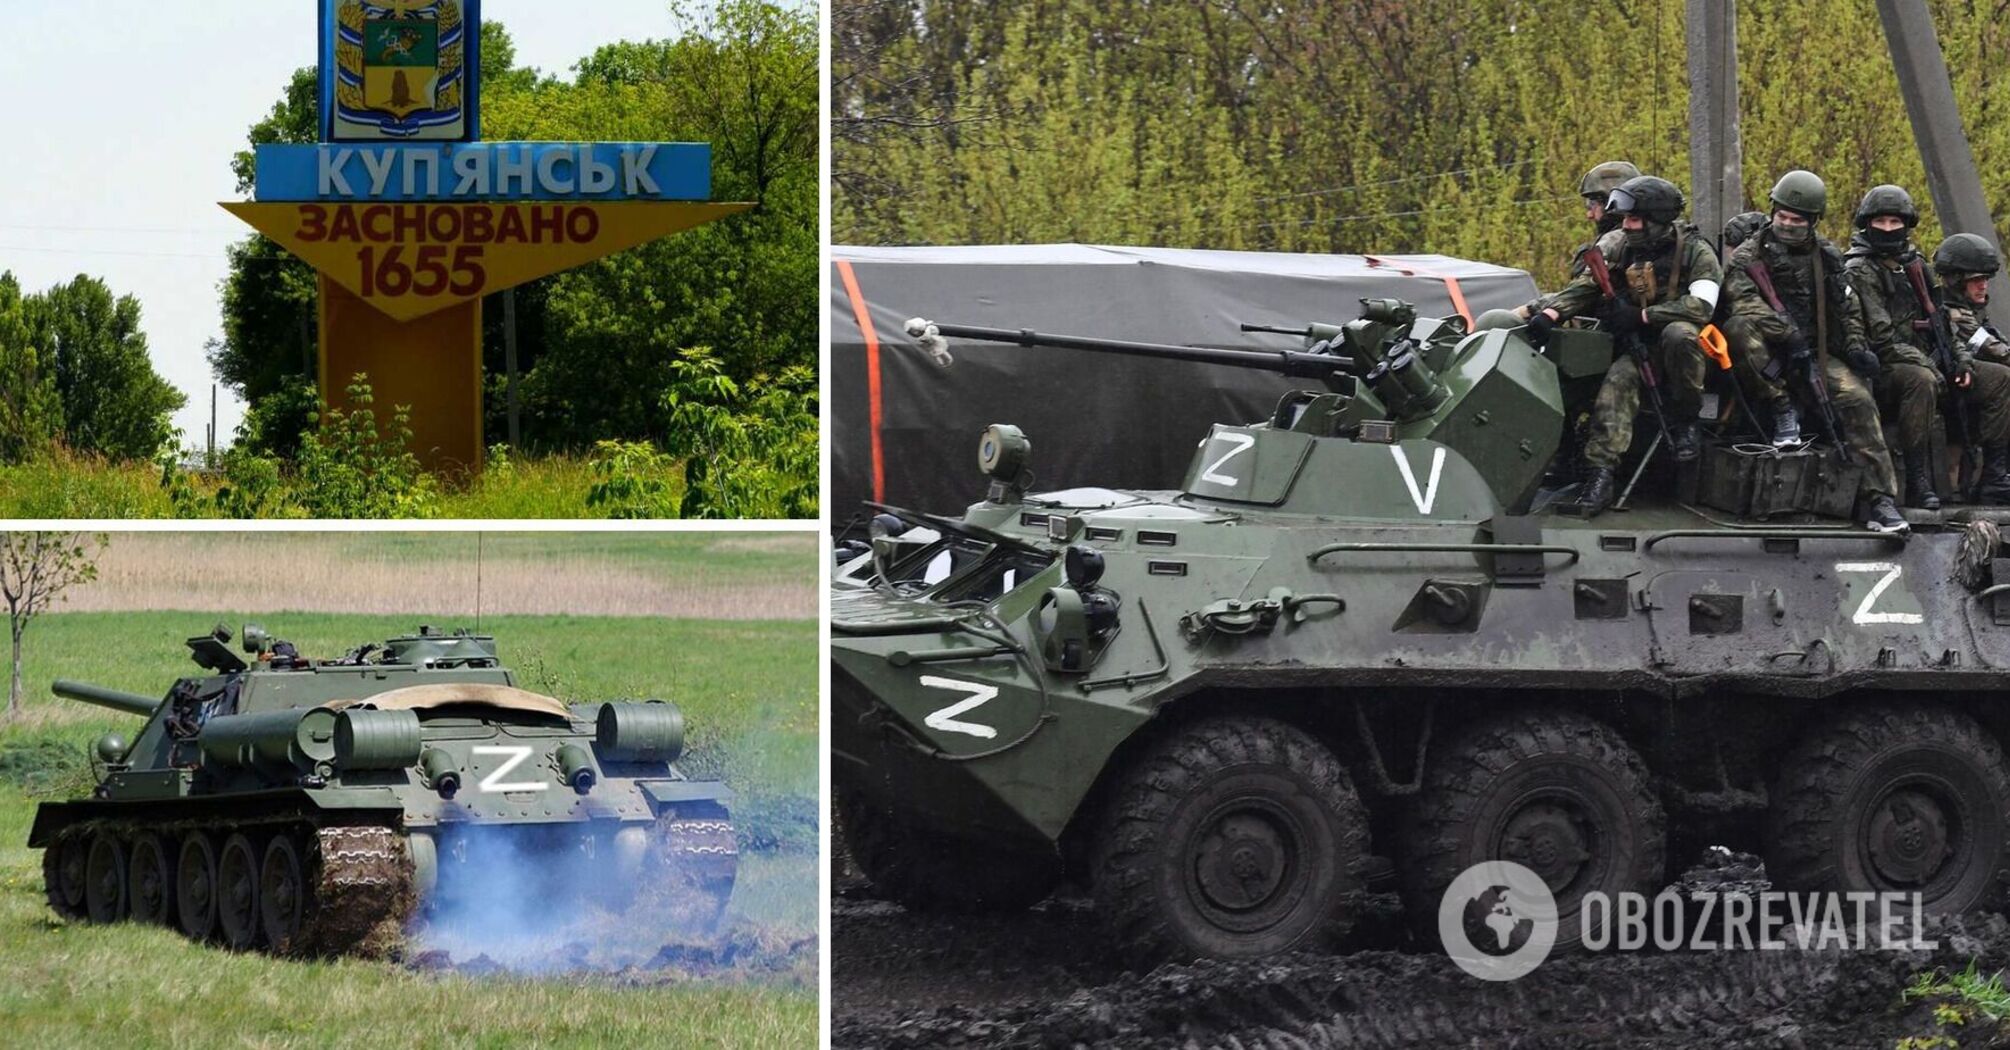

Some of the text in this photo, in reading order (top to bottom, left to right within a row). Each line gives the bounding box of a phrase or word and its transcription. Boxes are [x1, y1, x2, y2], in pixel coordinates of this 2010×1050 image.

[295, 204, 600, 244] ЗАСНОВАНО
[357, 245, 486, 298] 1655
[1202, 431, 1256, 486] Z
[1389, 445, 1447, 515] V
[1835, 562, 1923, 625] Z
[471, 745, 549, 793] Z
